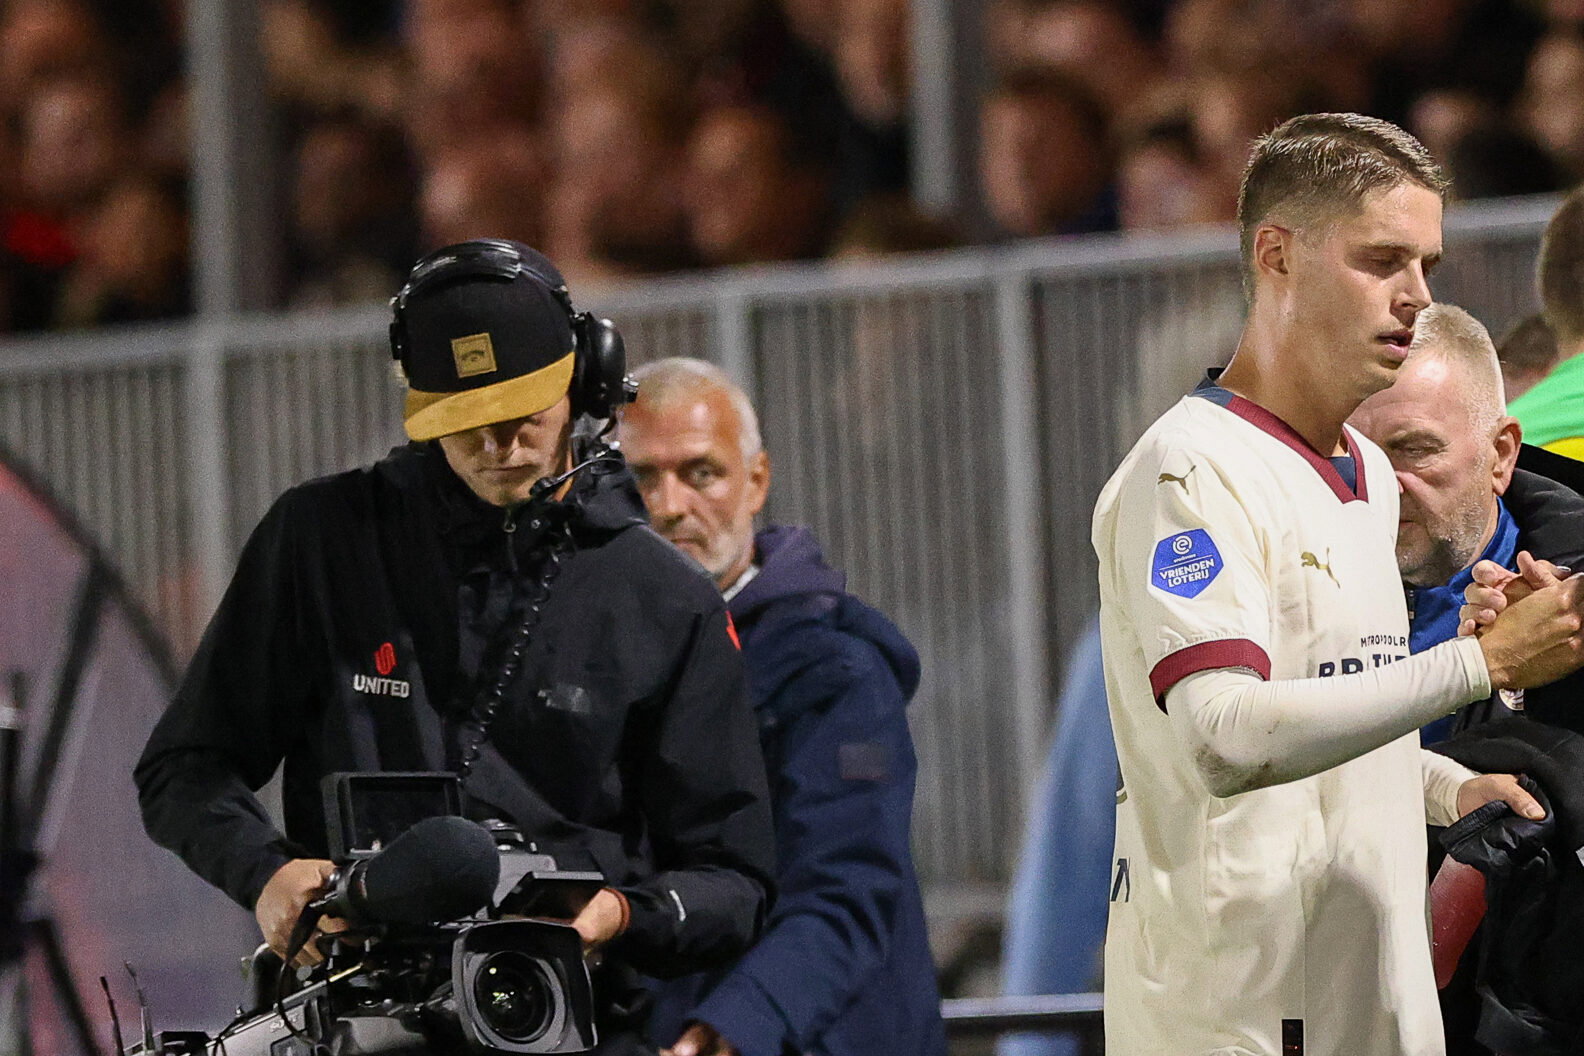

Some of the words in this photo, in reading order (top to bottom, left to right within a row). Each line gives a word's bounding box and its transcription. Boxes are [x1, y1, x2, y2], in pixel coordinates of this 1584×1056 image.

[1159, 558, 1215, 580] VRIENDEN
[1167, 568, 1210, 588] LOTERIJ
[353, 673, 410, 698] UNITED
